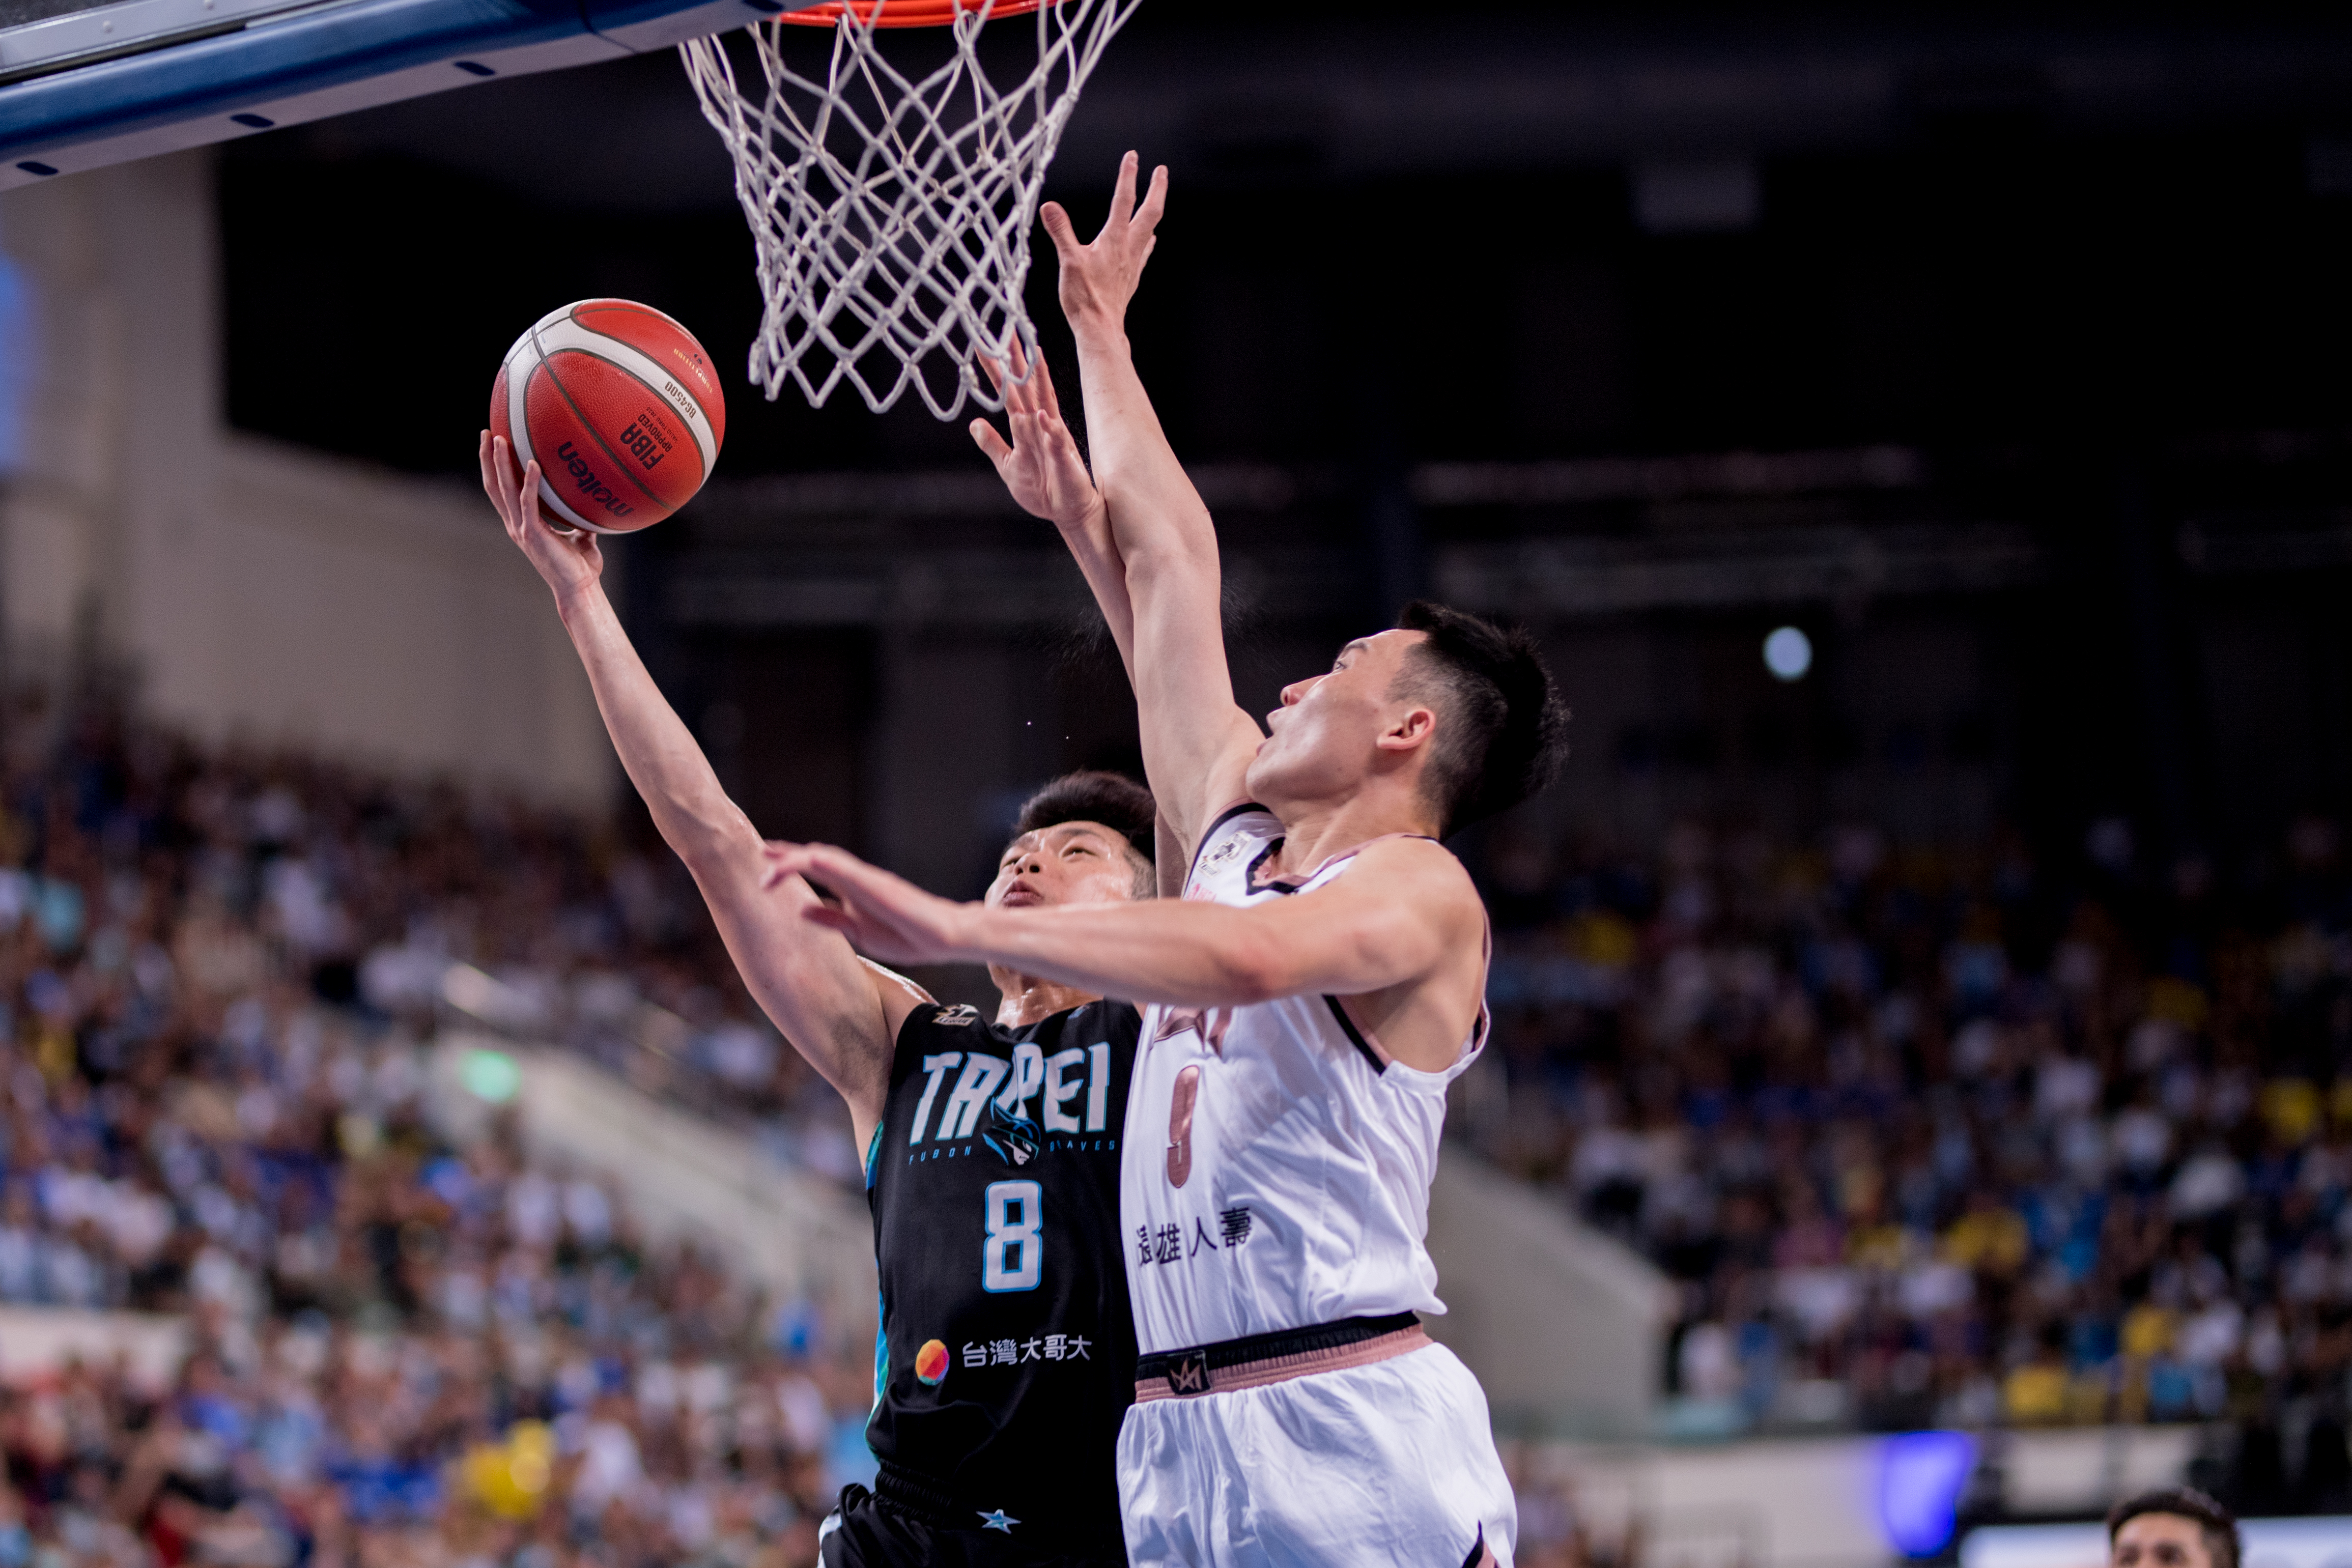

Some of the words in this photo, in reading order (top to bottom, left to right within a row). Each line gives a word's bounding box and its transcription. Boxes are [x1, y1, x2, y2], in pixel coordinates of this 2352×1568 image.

[665, 381, 696, 419] BG4500
[620, 422, 664, 470] FIBA
[638, 414, 672, 452] APPROVED
[558, 441, 634, 517] molten
[909, 1146, 971, 1165] FUBON
[982, 1179, 1043, 1293] 8
[962, 1333, 1092, 1367] 台灣大哥大
